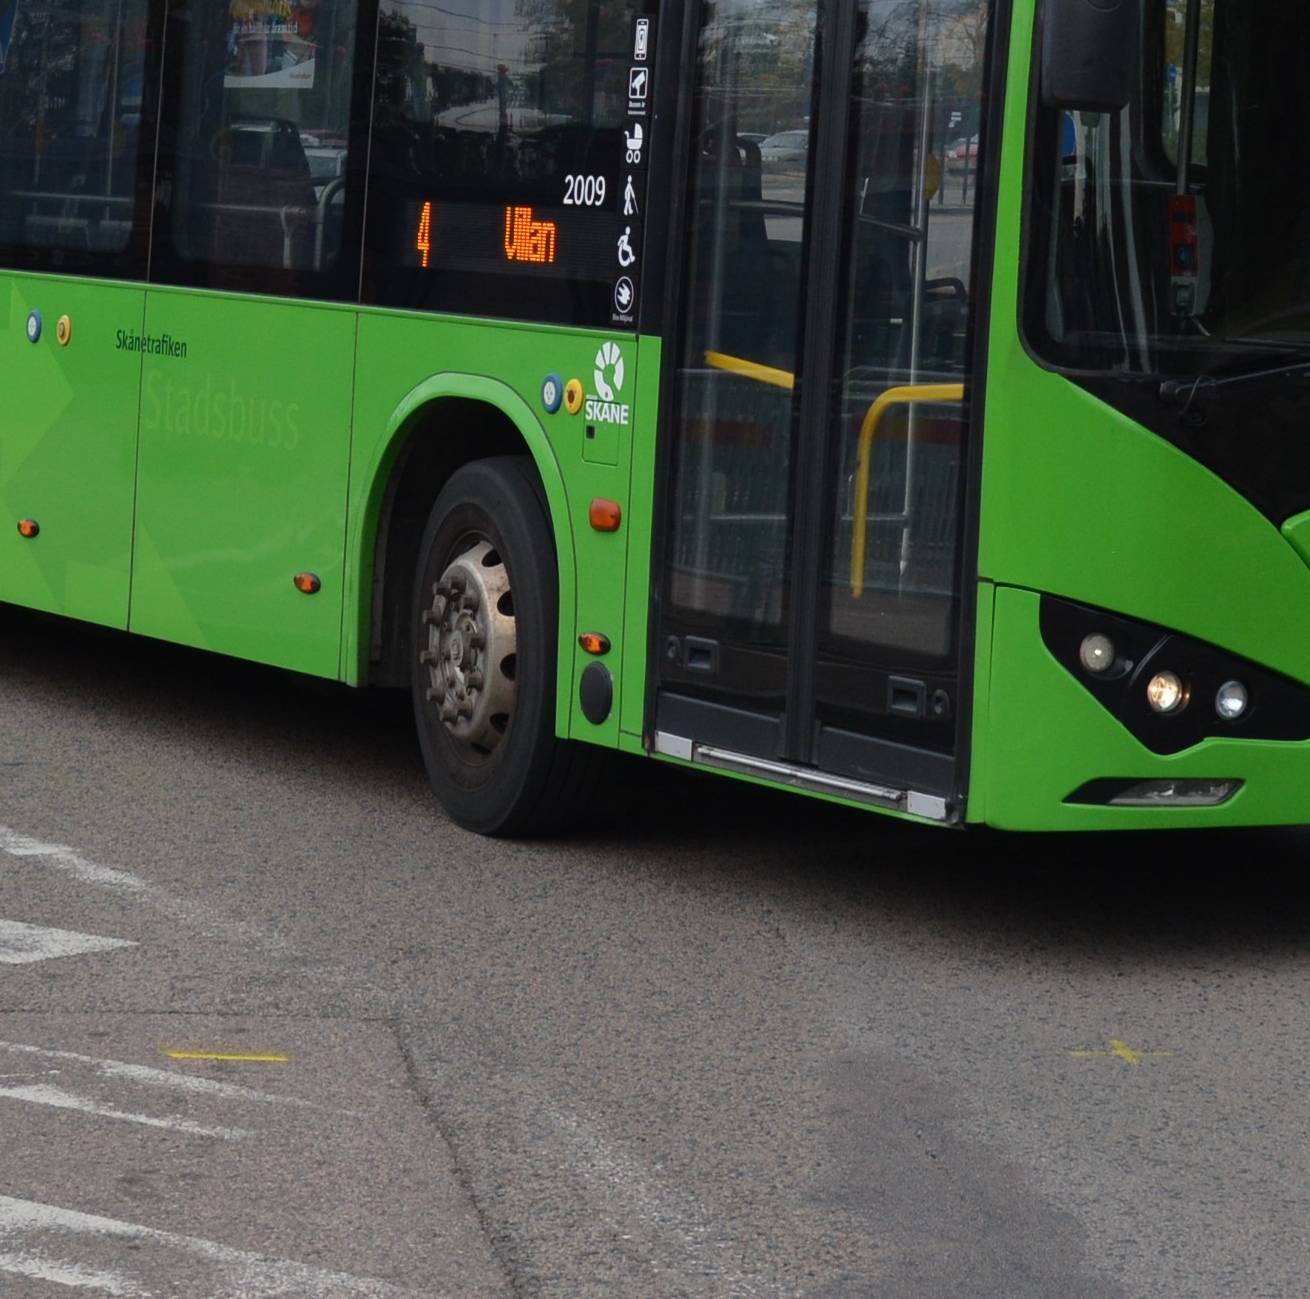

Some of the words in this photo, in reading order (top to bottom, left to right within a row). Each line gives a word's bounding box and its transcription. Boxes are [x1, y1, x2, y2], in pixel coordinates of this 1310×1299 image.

[563, 174, 606, 206] 2009
[417, 201, 431, 268] 4
[504, 206, 557, 263] Villan
[115, 329, 188, 358] Skånetrafiken
[143, 368, 299, 450] Stadsbuss
